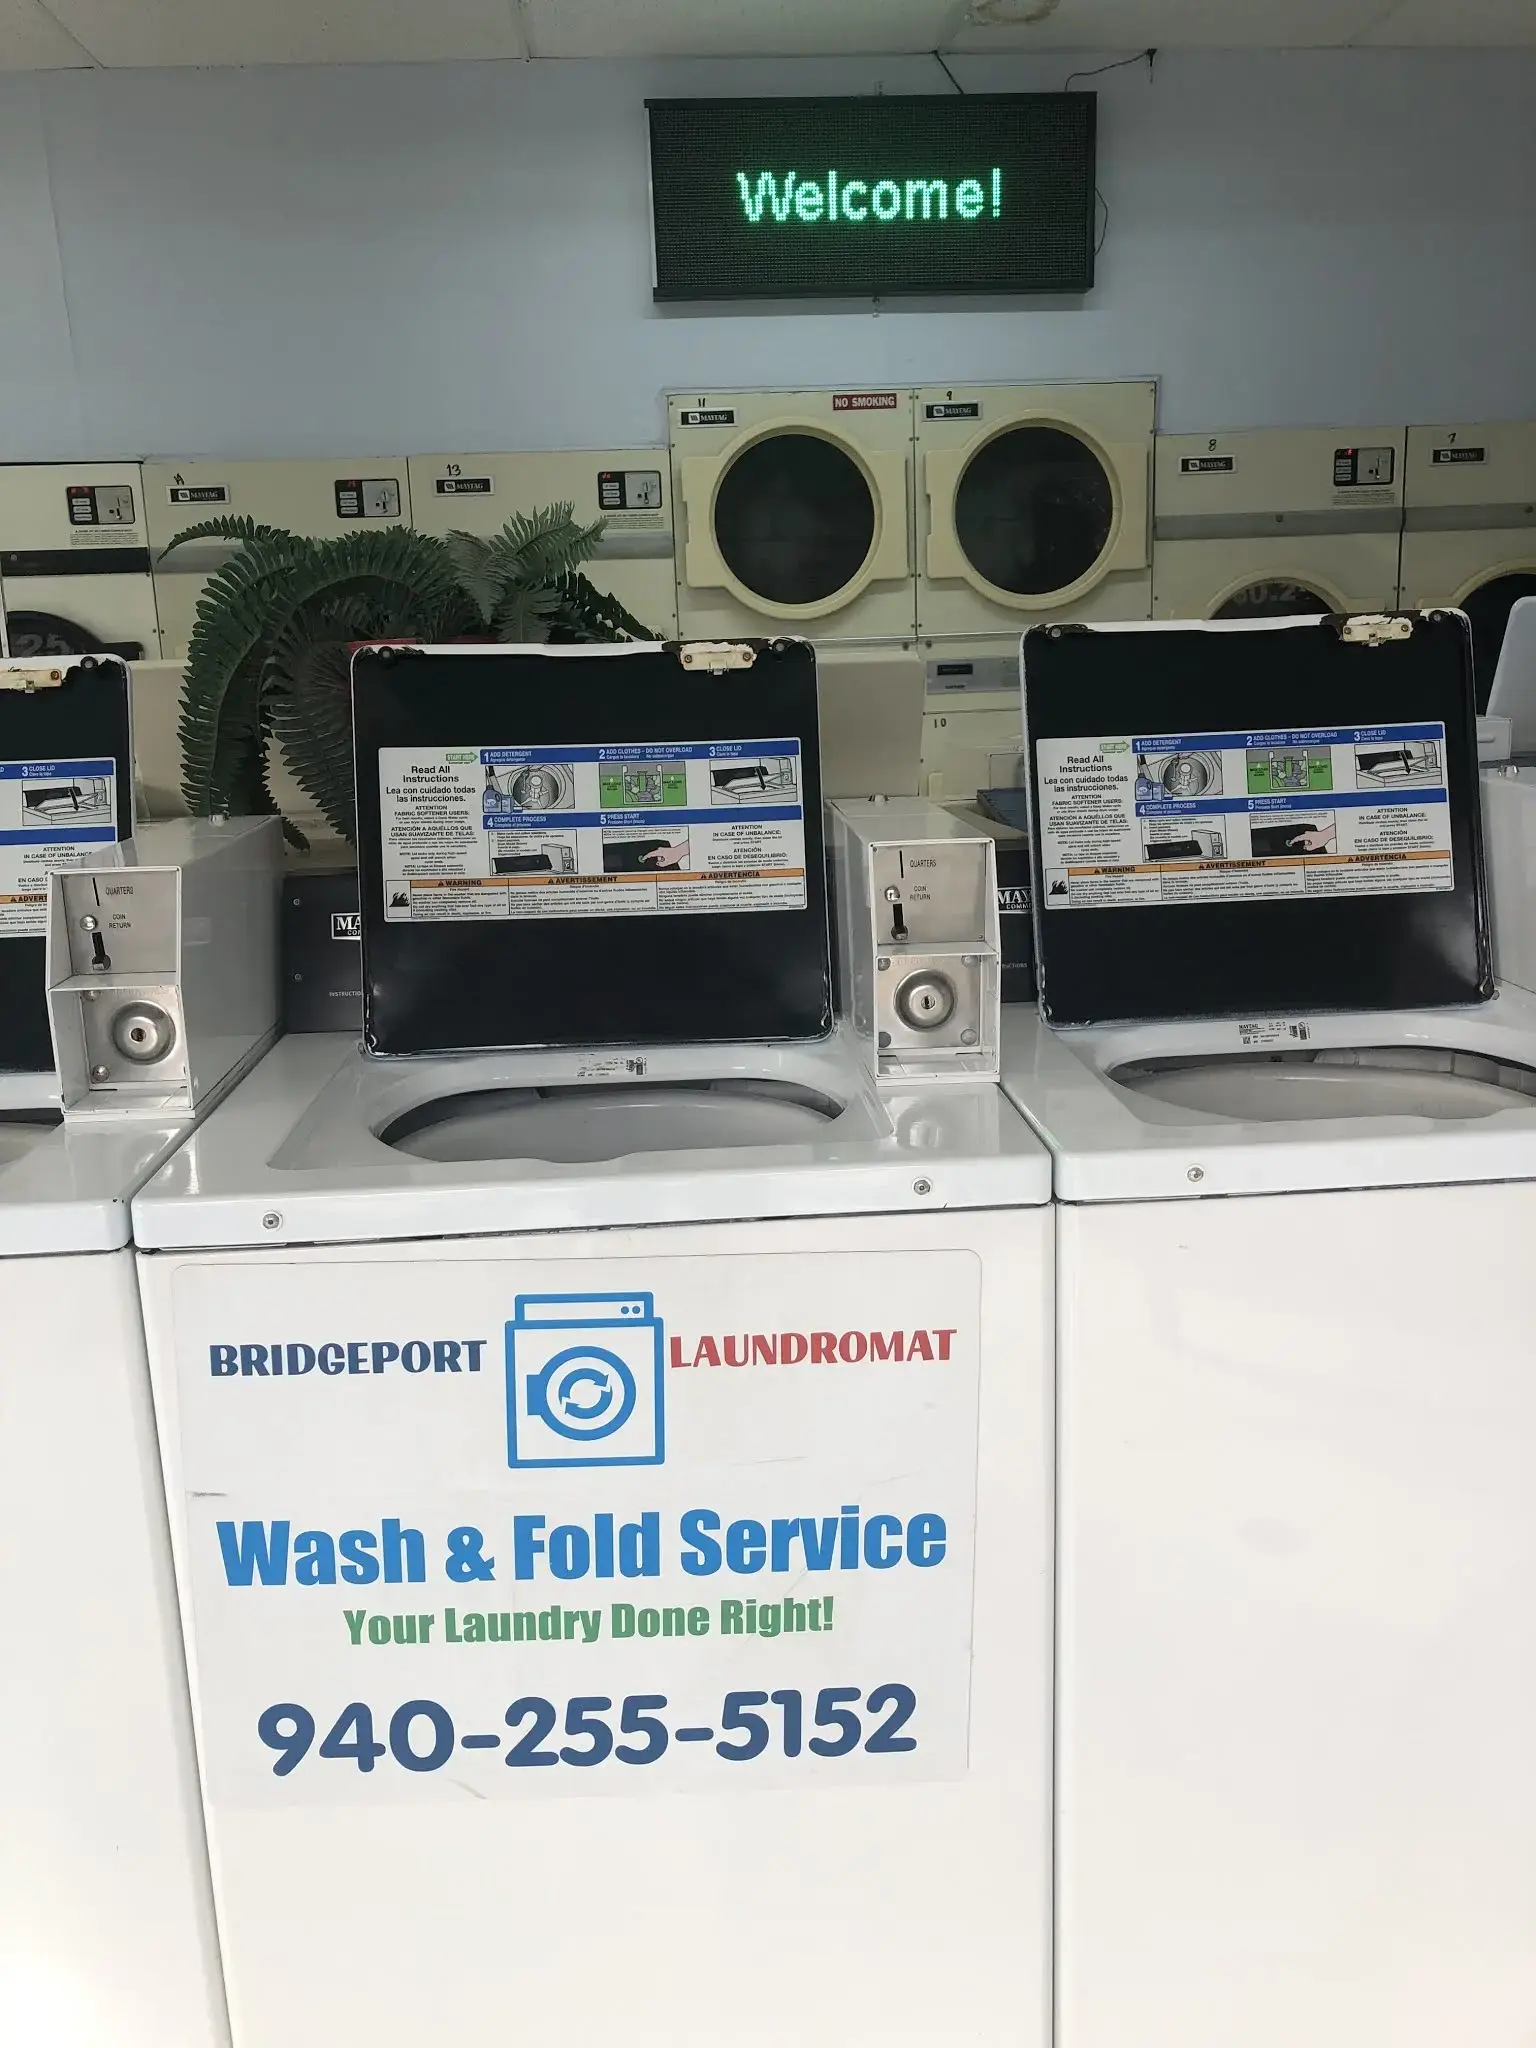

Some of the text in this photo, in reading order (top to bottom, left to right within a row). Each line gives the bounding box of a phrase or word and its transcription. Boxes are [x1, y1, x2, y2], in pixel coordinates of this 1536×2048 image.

[736, 167, 1002, 222] Welcome!
[946, 391, 953, 400] 9
[835, 396, 895, 408] NO SMOKING
[944, 407, 972, 415] MAYTAG
[1208, 438, 1217, 452] 8
[446, 464, 461, 476] 13
[934, 718, 947, 729] 10
[1246, 736, 1252, 746] 2
[1353, 731, 1361, 741] 3
[1135, 741, 1140, 751] 1
[599, 749, 605, 759] 2
[709, 746, 716, 757] 3
[484, 752, 489, 762] 1
[1067, 755, 1104, 764] Read All
[21, 766, 29, 776] 3
[411, 765, 450, 774] Read All
[1059, 764, 1113, 773] Instructions
[403, 774, 459, 783] Instructions
[1044, 777, 1058, 785] Lea
[1075, 775, 1106, 783] cuidado
[386, 786, 401, 795] Lea
[419, 786, 451, 794] cuidado
[453, 785, 476, 794] todas
[1066, 783, 1119, 792] instrucciones.
[396, 794, 466, 803] las instrucciones.
[1248, 800, 1254, 809] 5
[1139, 805, 1145, 815] 4
[487, 817, 493, 827] 4
[600, 814, 606, 824] 5
[1355, 853, 1407, 862] ADVERTENCIA
[910, 859, 937, 868] QUARTERS
[1206, 860, 1267, 868] AVERTISSEMENT
[556, 876, 618, 884] AVERTISSEMENT
[708, 871, 761, 879] ADVERTENCIA
[105, 886, 134, 896] QUARTERS
[909, 893, 931, 901] RETURN
[112, 913, 126, 921] COIN
[108, 921, 131, 929] RETURN
[209, 1329, 957, 1377] BRIDGEPORT LAUNDROMAT
[216, 1504, 948, 1587] Wash & Fold Service
[343, 1596, 835, 1646] Your Laundry Done Right!
[256, 1682, 919, 1778] 940-255-5152
